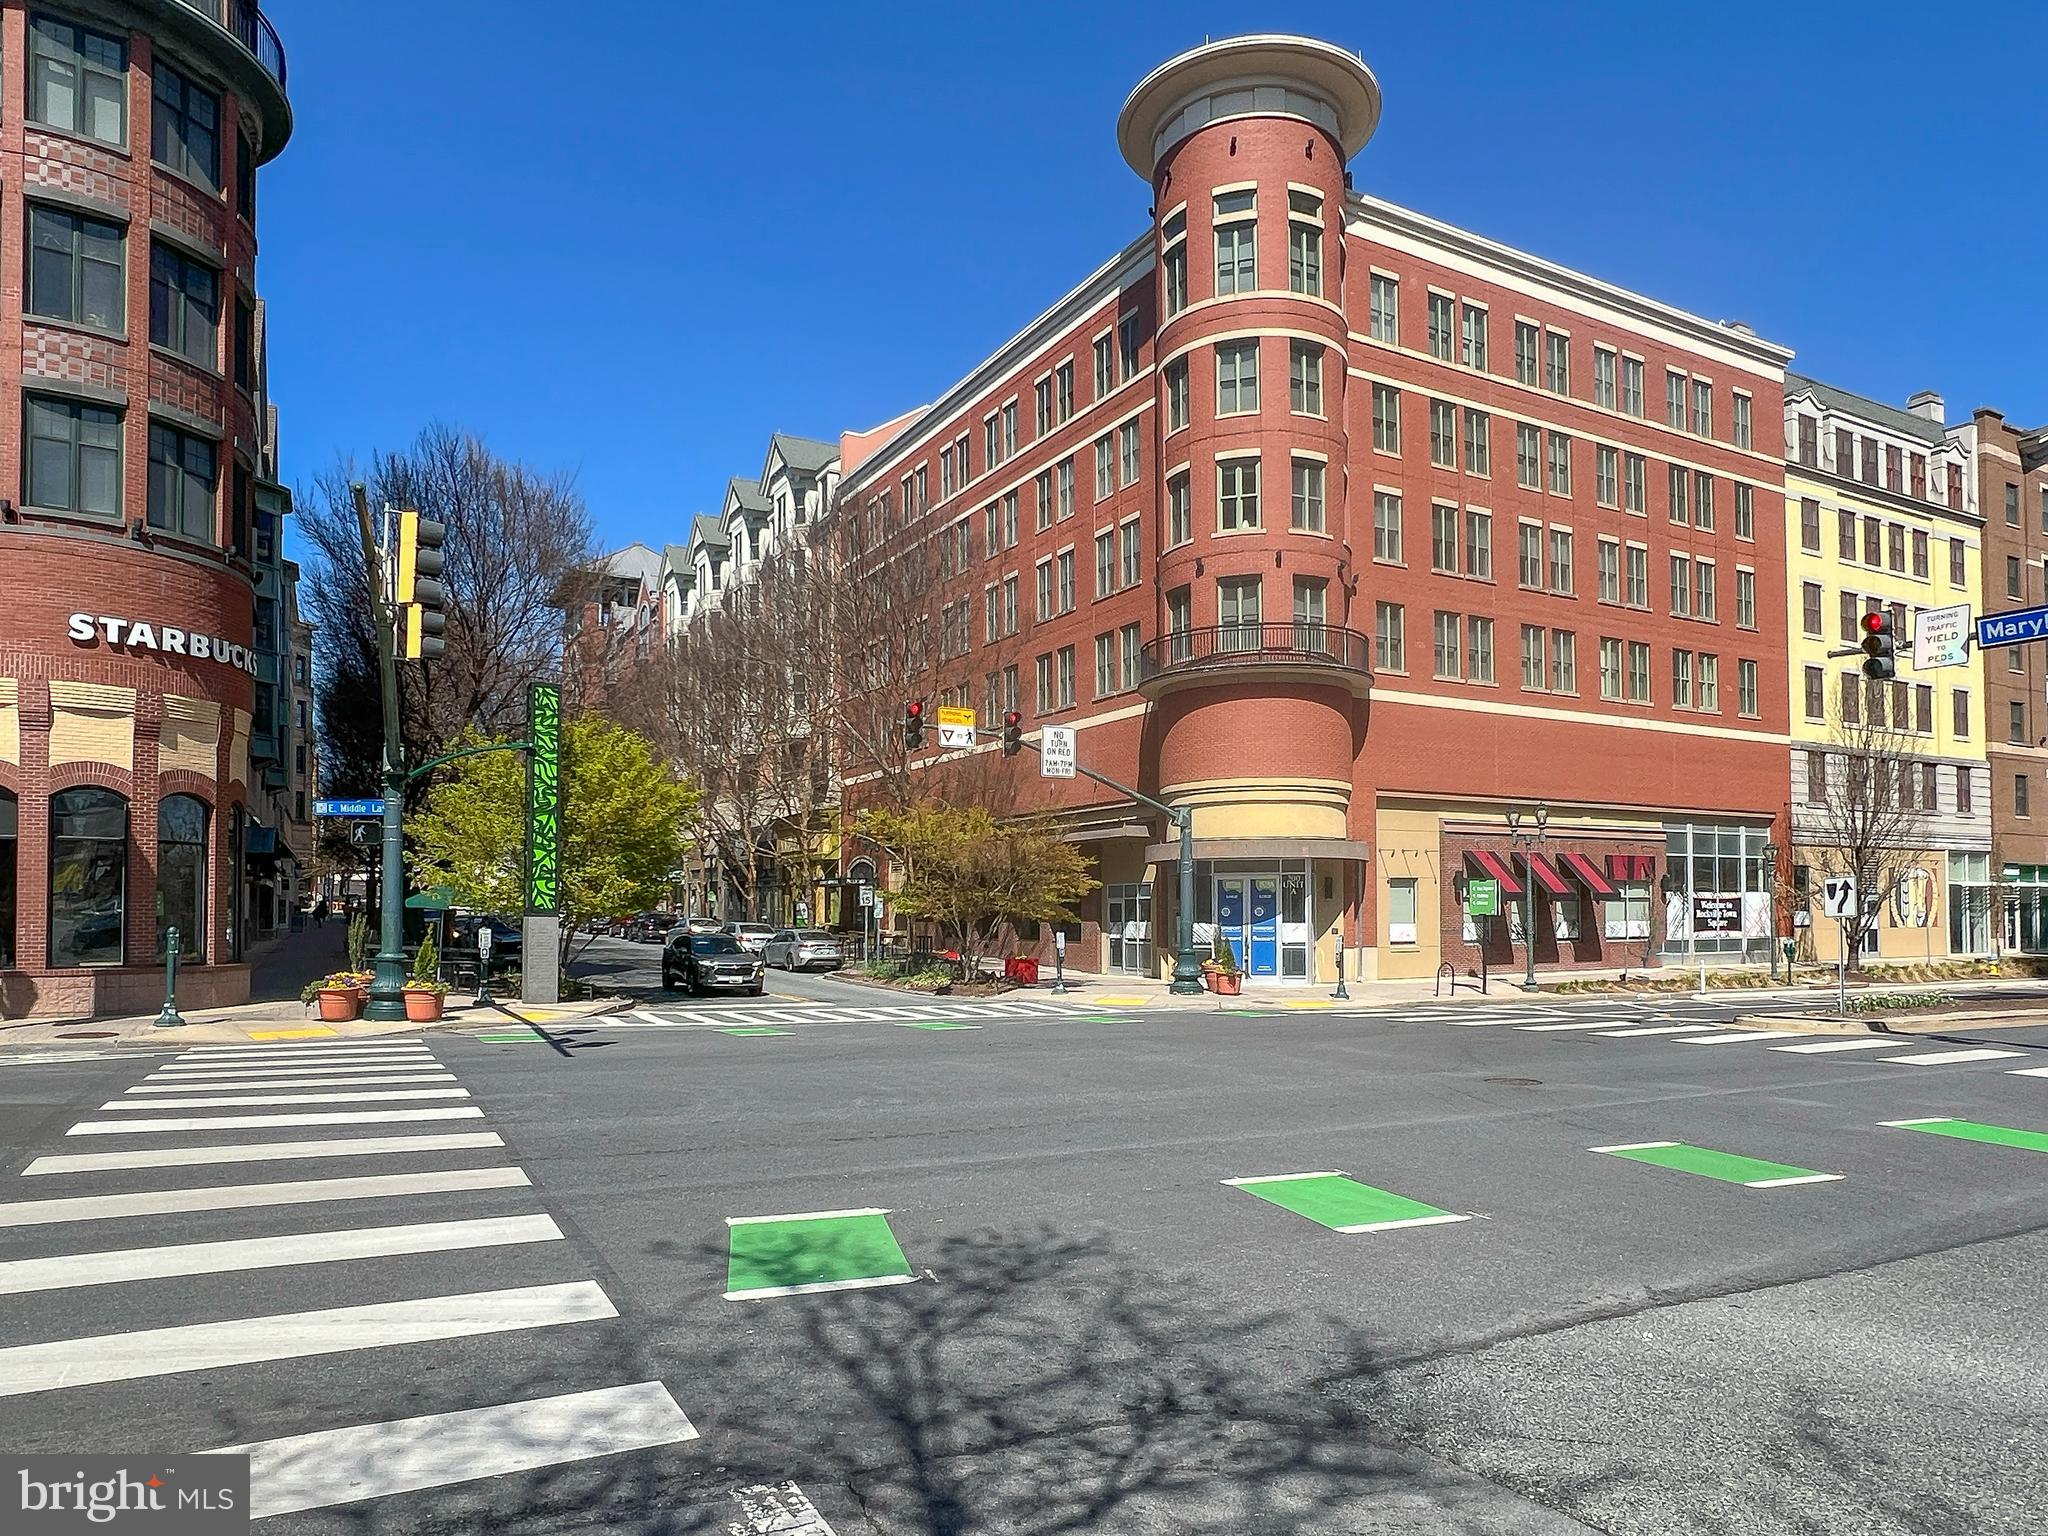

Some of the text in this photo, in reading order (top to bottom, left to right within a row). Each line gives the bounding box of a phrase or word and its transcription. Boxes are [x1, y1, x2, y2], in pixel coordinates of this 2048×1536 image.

[1926, 611, 1959, 623] TURNING
[1927, 621, 1958, 633] TRAFFIC
[1925, 631, 1959, 645] YIELD
[67, 612, 258, 677] STARBUCKS
[1937, 644, 1946, 652] TO
[1927, 652, 1954, 663] PEDS
[1053, 731, 1064, 740] NO
[1050, 740, 1068, 748] TURN
[1058, 749, 1071, 757] RED
[1045, 760, 1073, 768] 7AM-7PM
[328, 803, 338, 813] E.
[340, 803, 367, 813] Middle
[1282, 880, 1304, 889] UNIT
[861, 896, 871, 905] 15
[1707, 918, 1729, 929] Sqare
